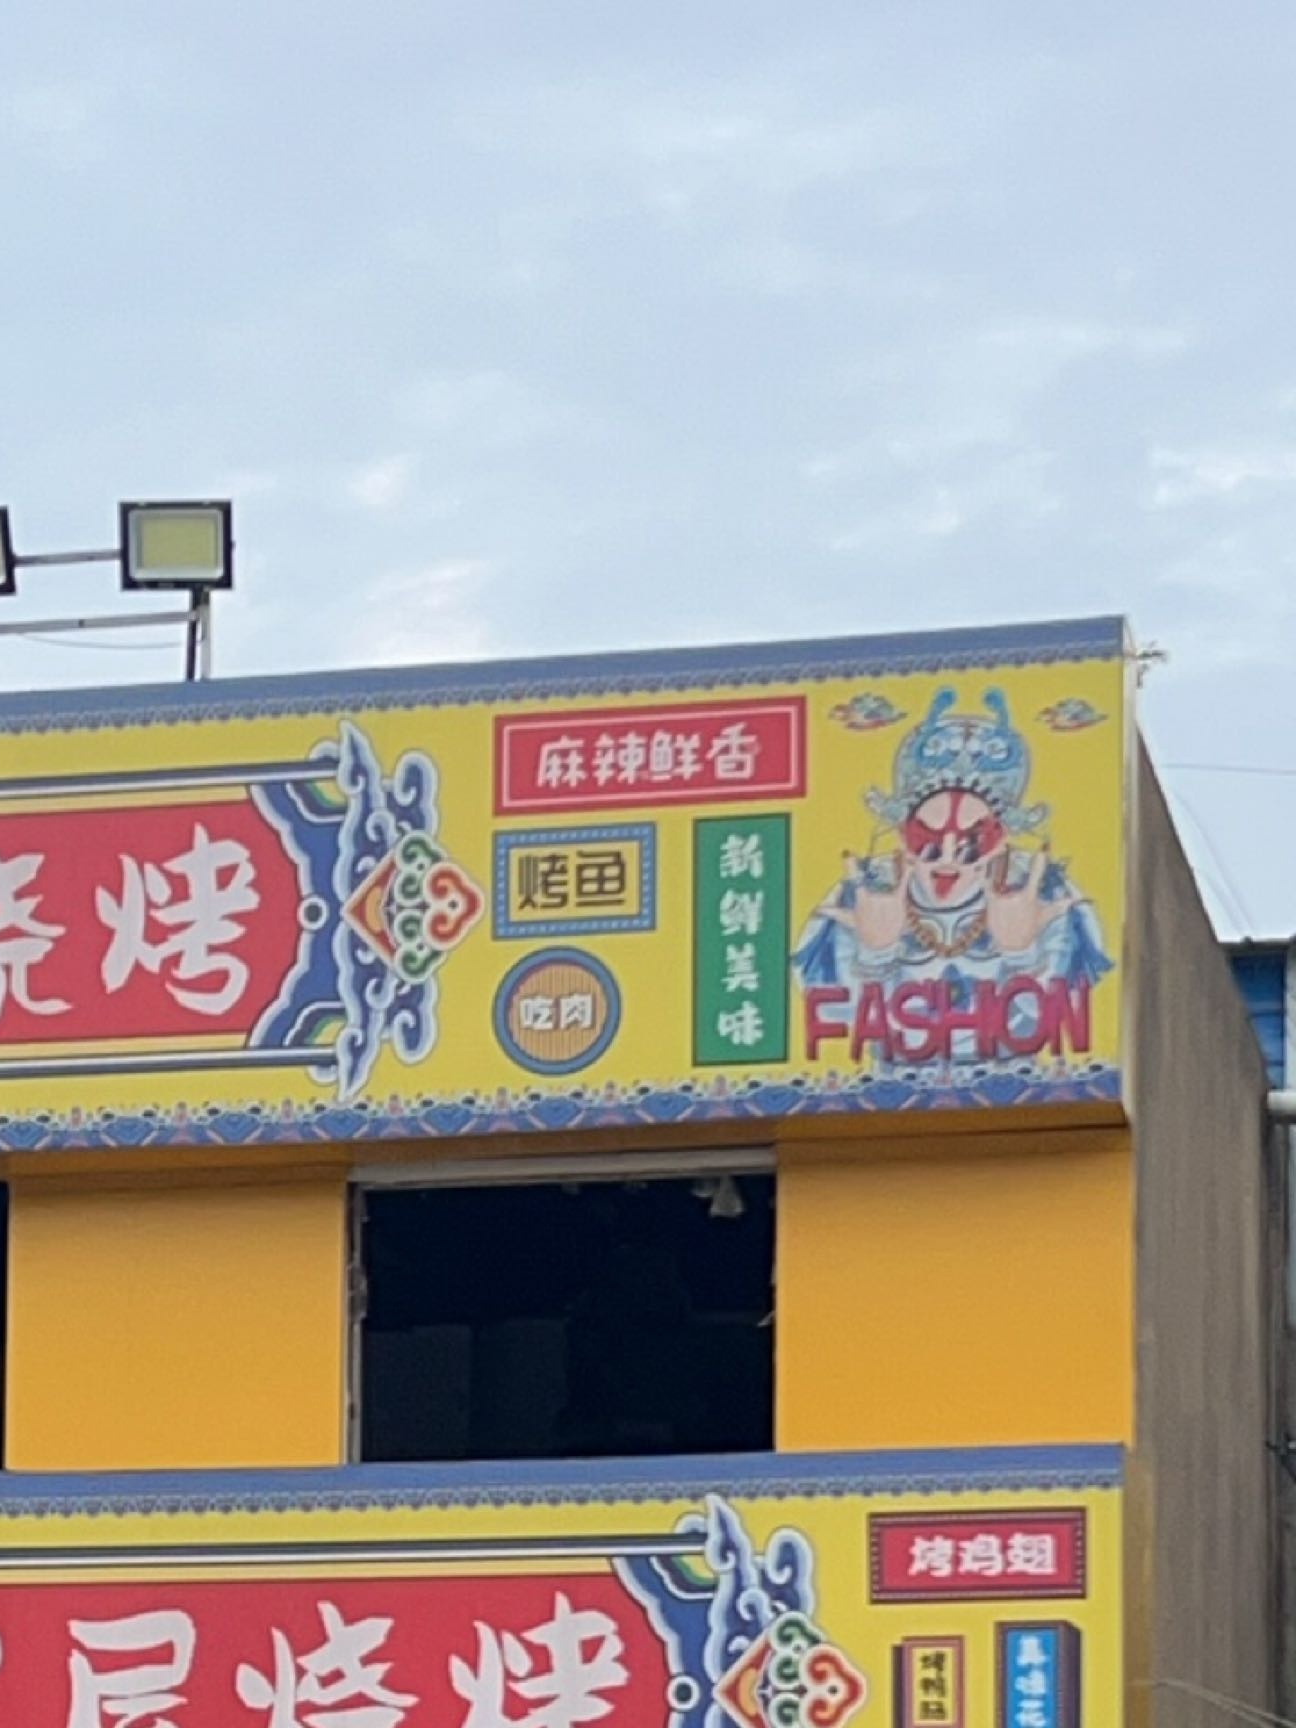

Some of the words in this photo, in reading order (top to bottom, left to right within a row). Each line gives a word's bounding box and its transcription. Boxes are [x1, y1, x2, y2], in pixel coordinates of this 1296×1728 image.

[537, 721, 758, 788] 麻辣鲜香
[517, 850, 626, 910] 烤鱼
[716, 834, 764, 1046] 新鲜美味
[518, 993, 594, 1031] 吃肉
[805, 974, 1092, 1063] FASHION
[907, 1532, 1058, 1578] 烤鸡翅
